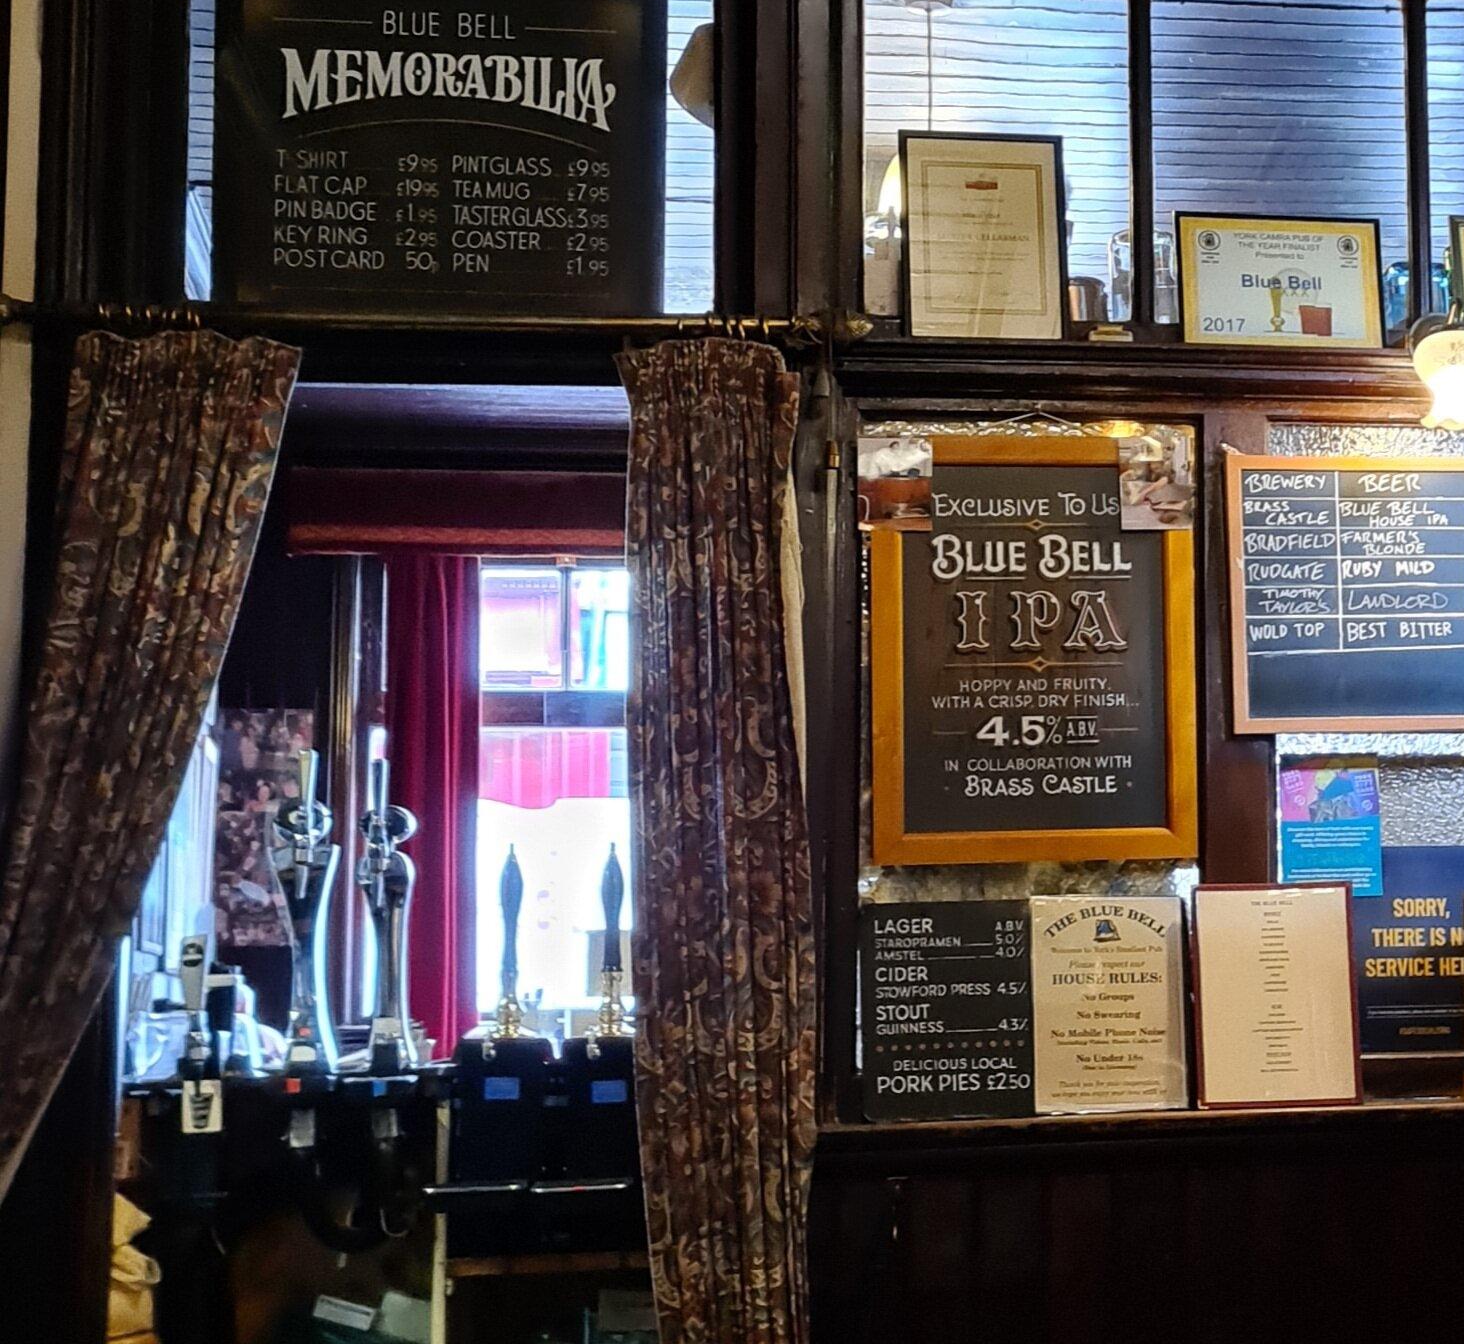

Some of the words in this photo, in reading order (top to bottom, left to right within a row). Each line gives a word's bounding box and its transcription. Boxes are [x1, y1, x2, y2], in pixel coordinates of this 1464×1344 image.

[382, 10, 440, 37] BLUE
[457, 12, 516, 39] BELL
[281, 47, 616, 133] MEMORABILIA
[274, 174, 318, 194] FLAT
[324, 176, 367, 195] CAP
[452, 180, 483, 198] TEA
[486, 181, 531, 200] MUG
[274, 199, 306, 218] PIN
[311, 200, 377, 222] BADGE
[452, 205, 511, 226] TASTER
[512, 207, 568, 228] GLASS
[274, 225, 313, 244] KEY
[318, 226, 368, 246] RING
[452, 230, 541, 250] COASTER
[453, 253, 489, 273] PEN
[1241, 274, 1282, 289] Blue
[1288, 276, 1322, 290] Bell
[1203, 317, 1245, 332] 2017
[1244, 473, 1326, 494] BREWERY
[1358, 474, 1421, 493] BEER
[1243, 501, 1290, 515] BRASS
[1338, 501, 1382, 517] BLUE
[1386, 501, 1435, 515] BELL
[1265, 511, 1330, 526] CASTLE
[1369, 515, 1415, 528] HOUSE
[1427, 515, 1449, 526] IPA
[1244, 532, 1336, 553] BRADFIELD
[1341, 531, 1420, 545] FARMER'S
[1362, 542, 1426, 556] BLONDE
[1247, 561, 1327, 582] RUDGATE
[1341, 559, 1383, 579] RUBY
[1396, 560, 1436, 577] MILD
[1348, 590, 1449, 611] LANDLORD
[1250, 624, 1288, 642] WOLD
[1293, 622, 1325, 638] TOP
[1346, 621, 1387, 642] BEST
[1399, 622, 1452, 640] BITTER
[959, 679, 1012, 693] HOPPY
[1016, 678, 1048, 692] AND
[931, 695, 970, 709] WITH
[973, 695, 985, 708] A
[1038, 694, 1069, 707] DRY
[976, 716, 1064, 747] 4.5%
[944, 759, 959, 772] IN
[967, 756, 1091, 772] COLLABORATION
[1095, 755, 1132, 769] WITH
[1393, 897, 1450, 919] SORRY,
[874, 917, 934, 934] LAGER
[1044, 912, 1077, 938] THE
[1079, 905, 1124, 920] BLUE
[1127, 908, 1167, 938] BELL
[874, 936, 962, 949] STAROPRAMEN
[1371, 927, 1426, 948] THERE
[1430, 927, 1446, 947] IS
[874, 950, 925, 961] AMSTEL
[874, 966, 929, 982] CIDER
[1365, 957, 1435, 978] SERVICE
[1052, 973, 1105, 985] HOUSE
[1109, 972, 1162, 984] RULES:
[875, 984, 947, 999] STOWFORD
[951, 983, 991, 996] PRESS
[876, 1003, 931, 1021] STOUT
[876, 1021, 945, 1035] GUINNESS
[893, 1058, 968, 1072] DELICIOUS
[971, 1057, 1017, 1070] LOCAL
[877, 1074, 934, 1094] PORK
[938, 1073, 981, 1091] PIES
